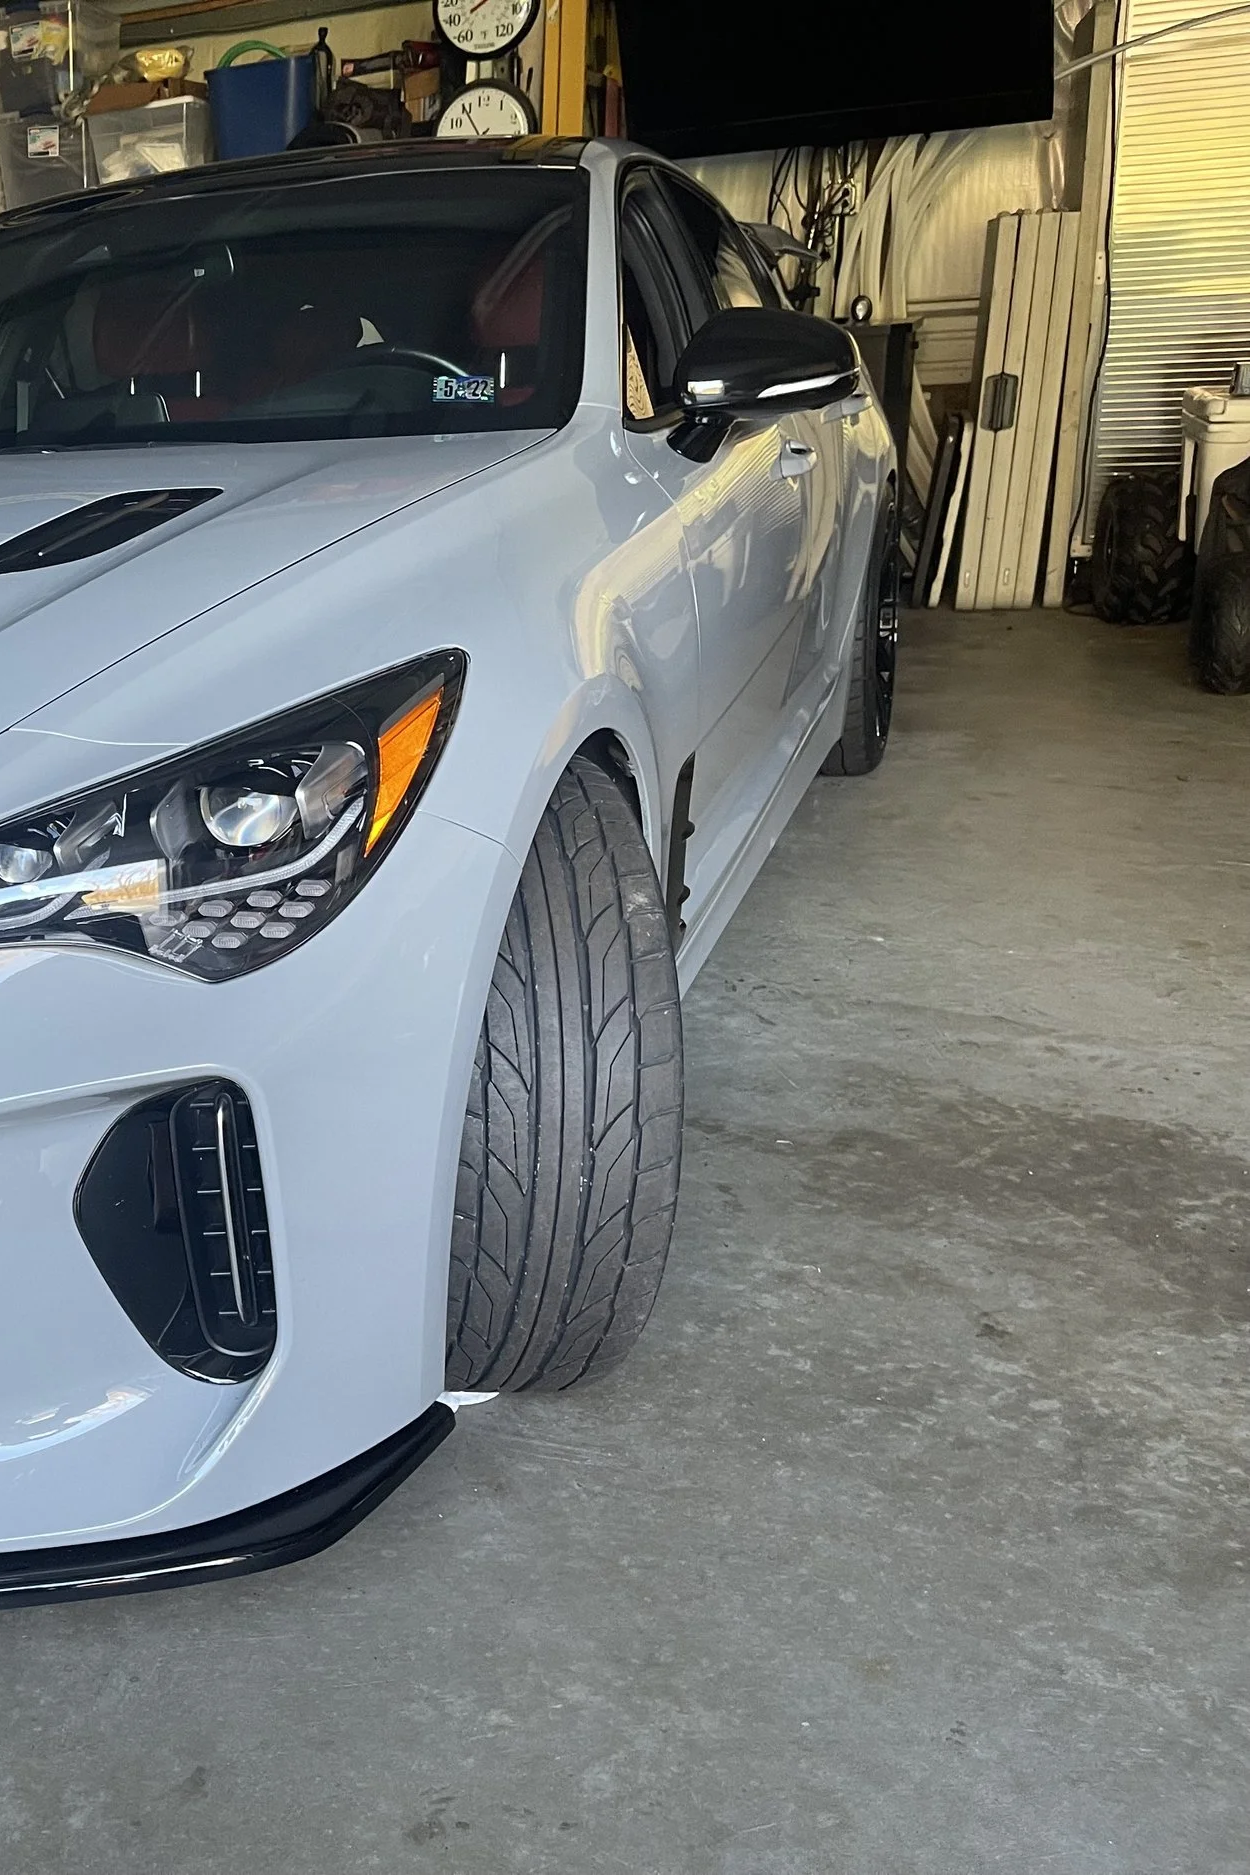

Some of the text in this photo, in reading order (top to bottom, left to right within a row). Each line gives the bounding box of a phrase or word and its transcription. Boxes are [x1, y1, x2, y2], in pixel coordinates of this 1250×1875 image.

[495, 23, 514, 37] 120
[478, 95, 490, 107] 12
[450, 117, 462, 129] 10
